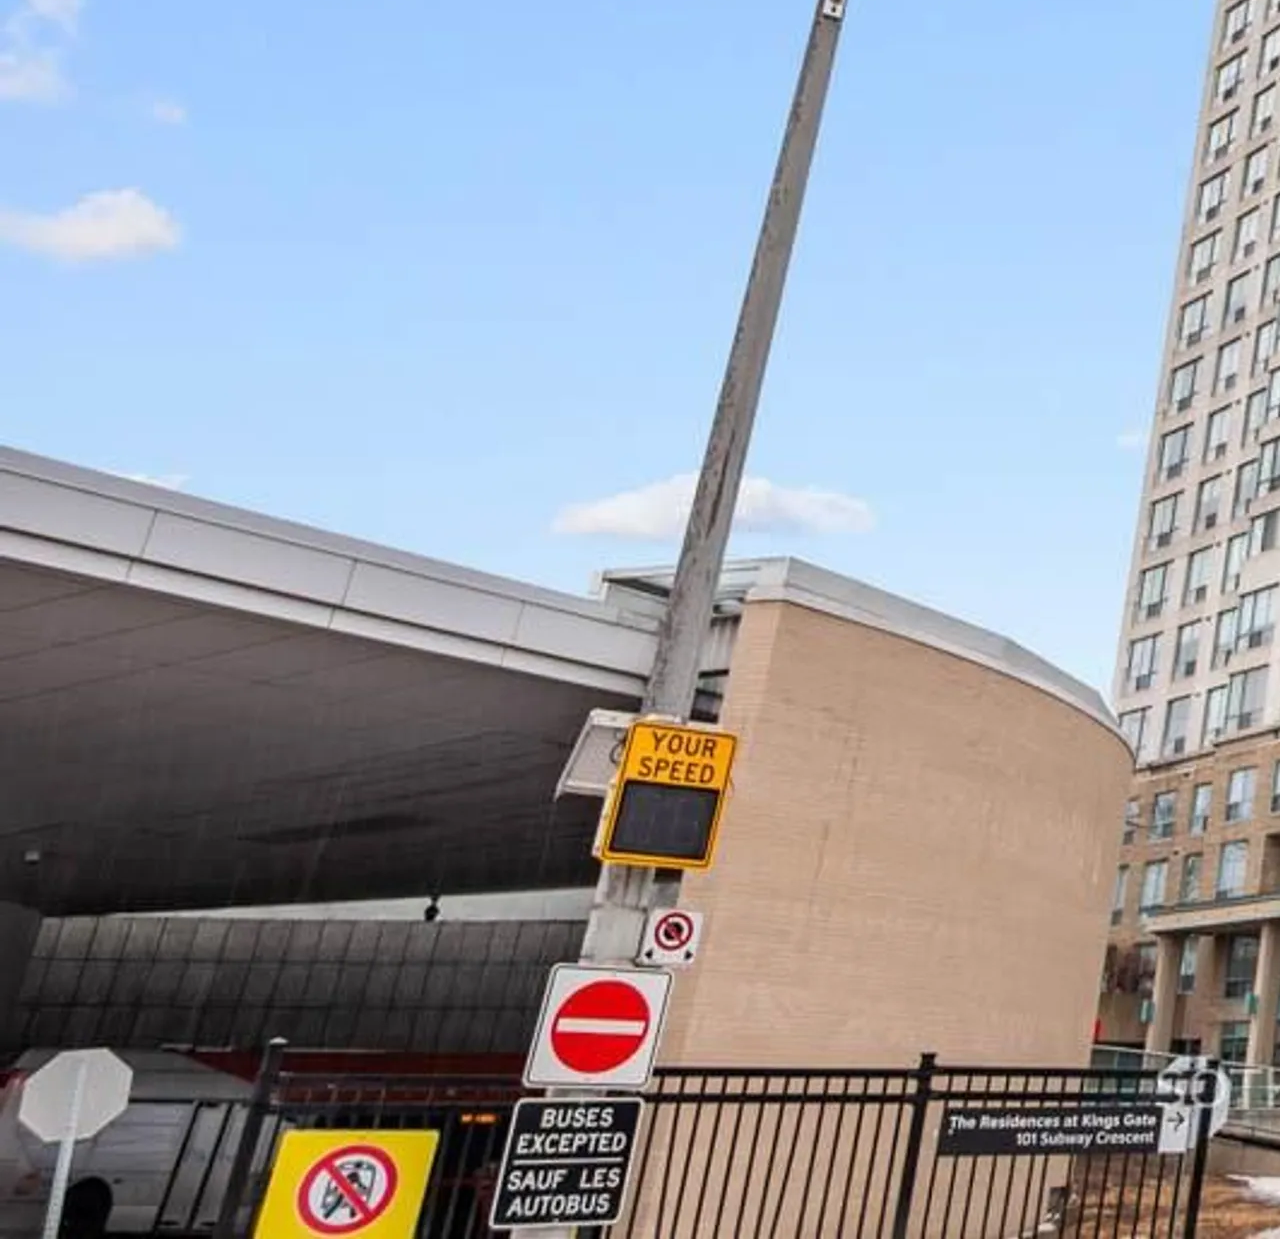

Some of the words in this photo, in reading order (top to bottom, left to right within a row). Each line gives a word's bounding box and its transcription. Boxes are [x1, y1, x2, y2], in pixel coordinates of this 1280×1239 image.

[652, 731, 717, 759] YOUR
[638, 756, 715, 784] SPEED
[540, 1108, 614, 1128] BUSES
[950, 1116, 975, 1130] The
[979, 1114, 1060, 1129] Residences
[1063, 1115, 1078, 1128] at
[1082, 1113, 1120, 1131] Kings
[1123, 1113, 1156, 1127] Gate
[516, 1132, 627, 1154] EXCEPTED
[1016, 1133, 1037, 1147] 101
[1040, 1132, 1093, 1148] Subway
[1096, 1132, 1154, 1145] Crescent
[507, 1169, 567, 1190] SAUF
[580, 1167, 622, 1189] LES
[506, 1193, 610, 1217] AUTOBUS
